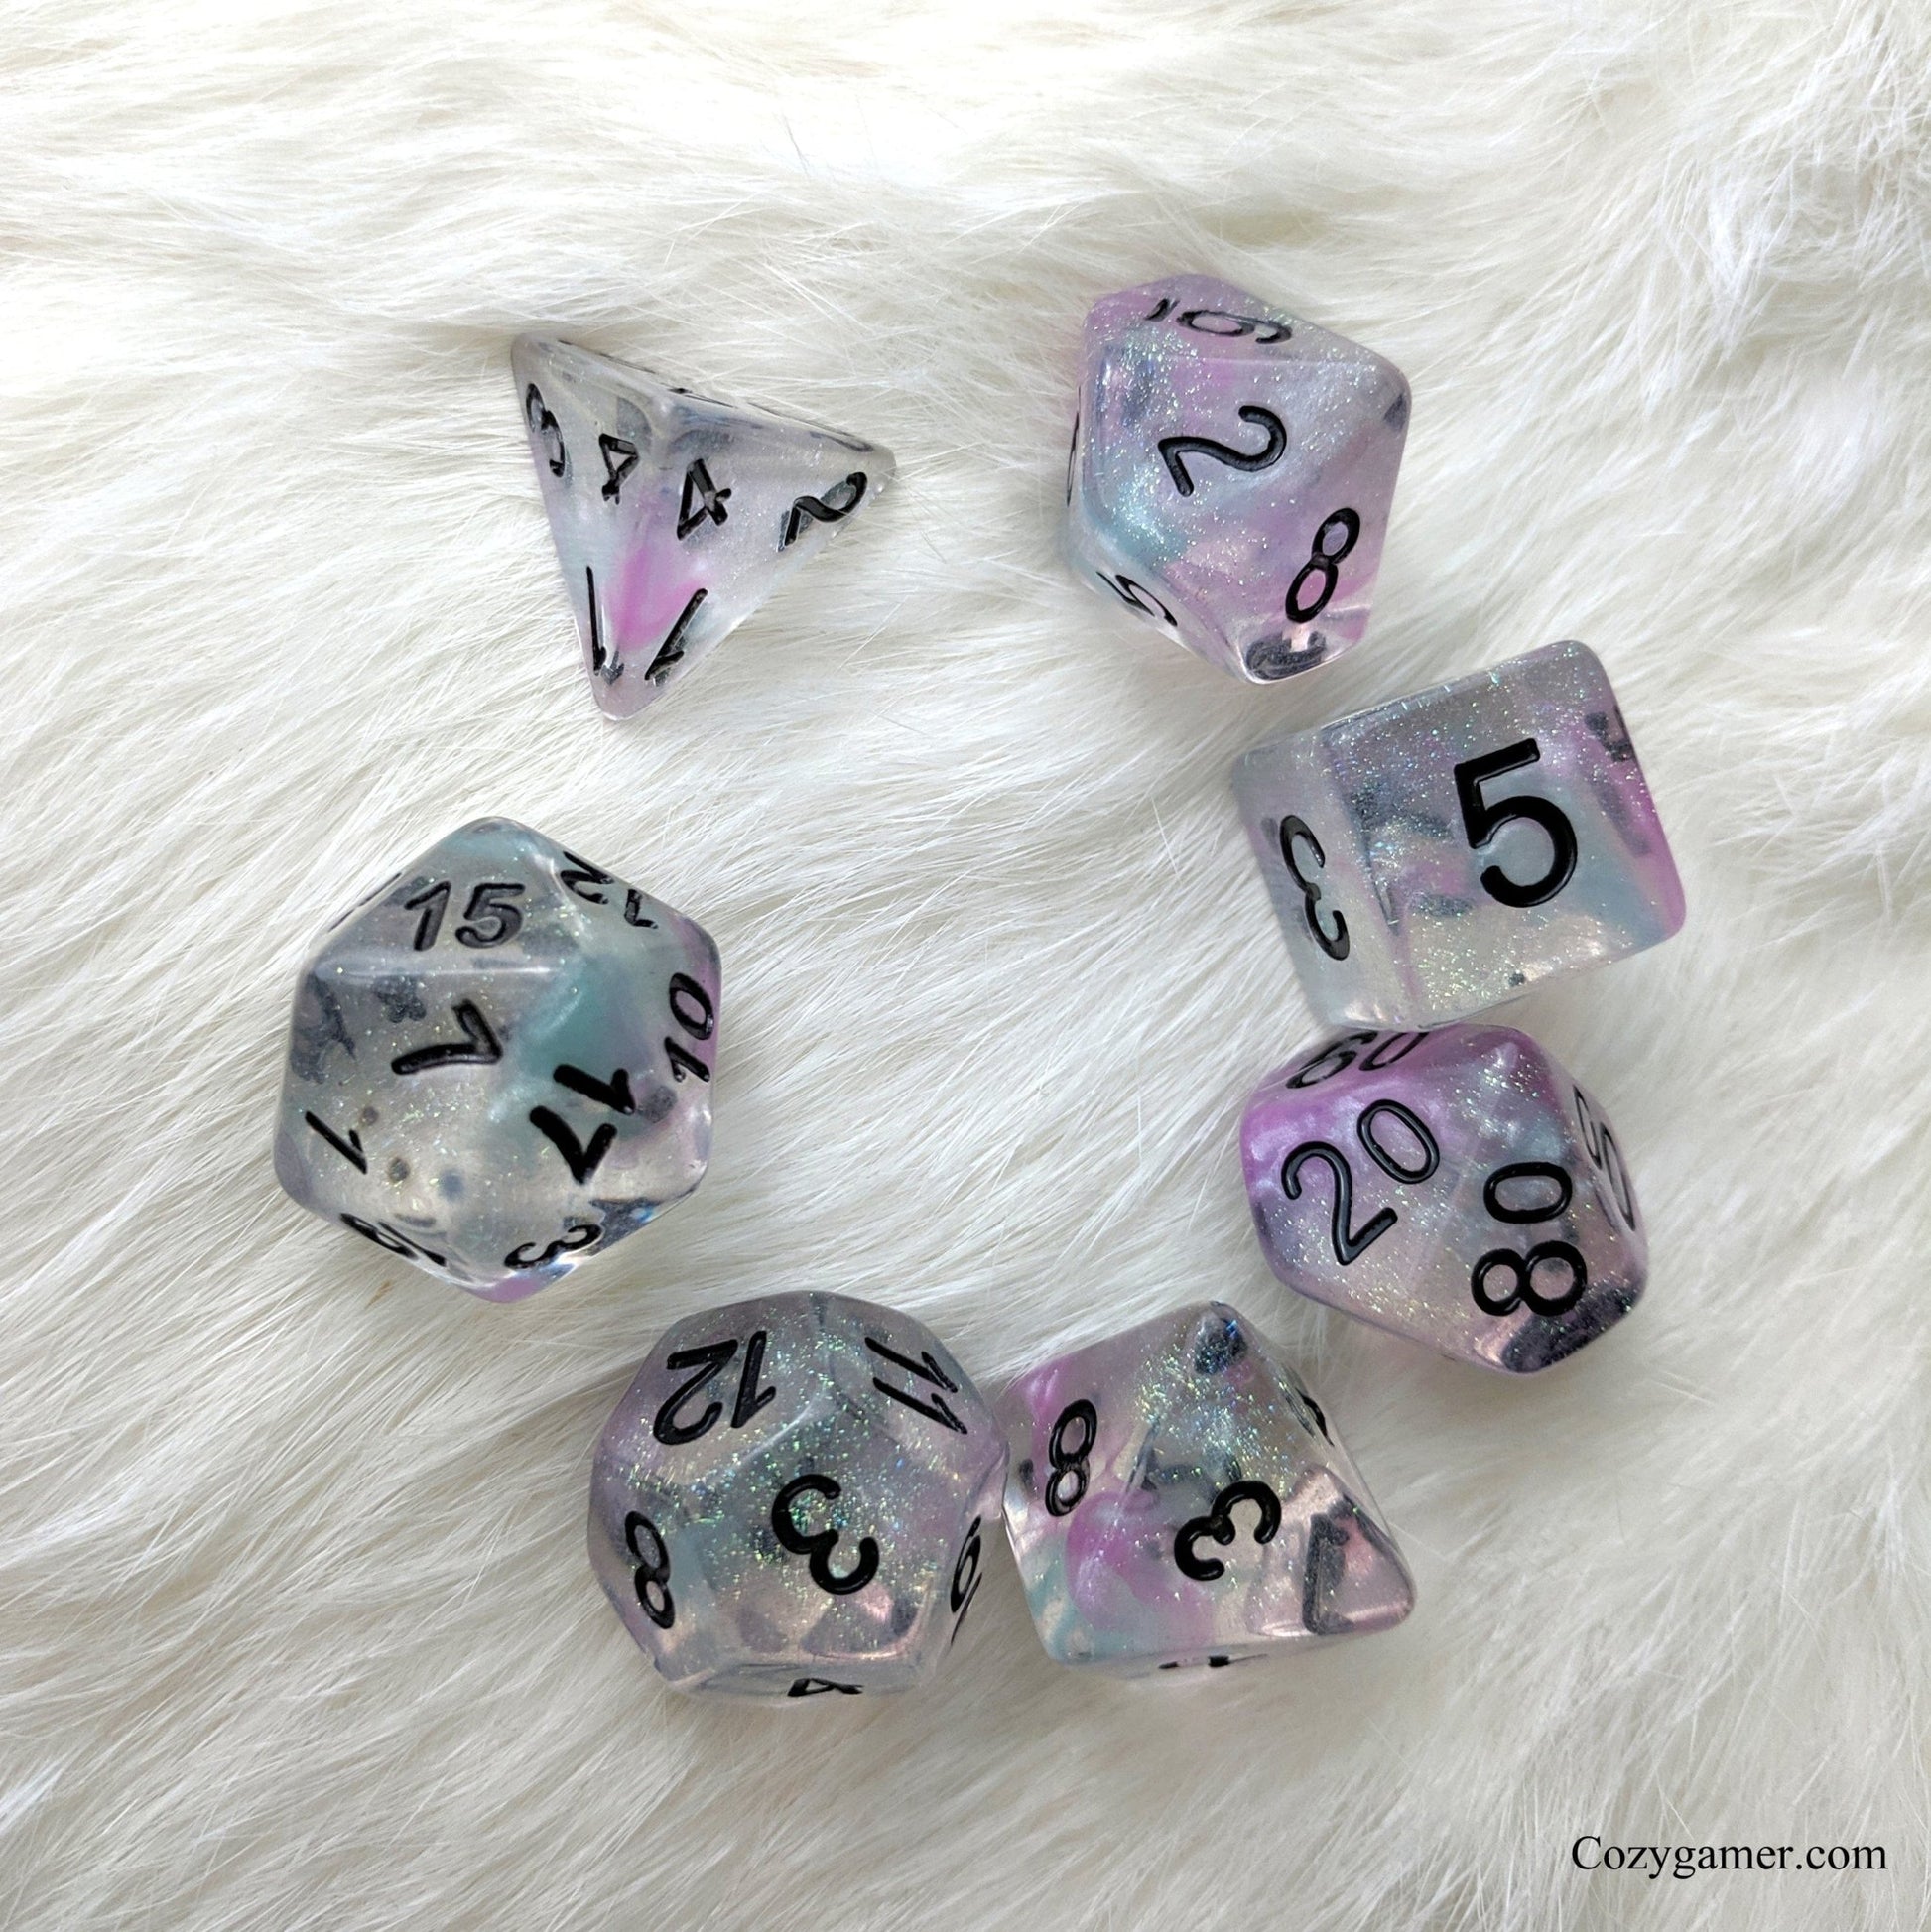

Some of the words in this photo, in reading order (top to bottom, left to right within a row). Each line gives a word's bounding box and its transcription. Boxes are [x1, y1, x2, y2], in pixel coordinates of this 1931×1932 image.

[598, 433, 640, 505] 4
[677, 458, 732, 541] 4
[1158, 405, 1288, 496] 2
[779, 471, 867, 550] 2
[1286, 507, 1360, 623] 8
[644, 587, 708, 681] 1
[1453, 738, 1578, 908] 5
[404, 881, 526, 951] 15
[1279, 815, 1350, 961] 3
[391, 999, 504, 1076] 7
[663, 972, 714, 1083] 10
[1286, 1031, 1429, 1089] 60
[305, 1110, 368, 1175] 1
[530, 1064, 635, 1185] 17
[1281, 1098, 1440, 1266] 20
[504, 1224, 602, 1270] 3
[1471, 1161, 1588, 1318] 80
[653, 1330, 777, 1446] 12
[864, 1336, 968, 1435] 11
[1045, 1398, 1097, 1518] 8
[624, 1510, 676, 1630] 8
[771, 1474, 880, 1596] 3
[1173, 1480, 1282, 1582] 3
